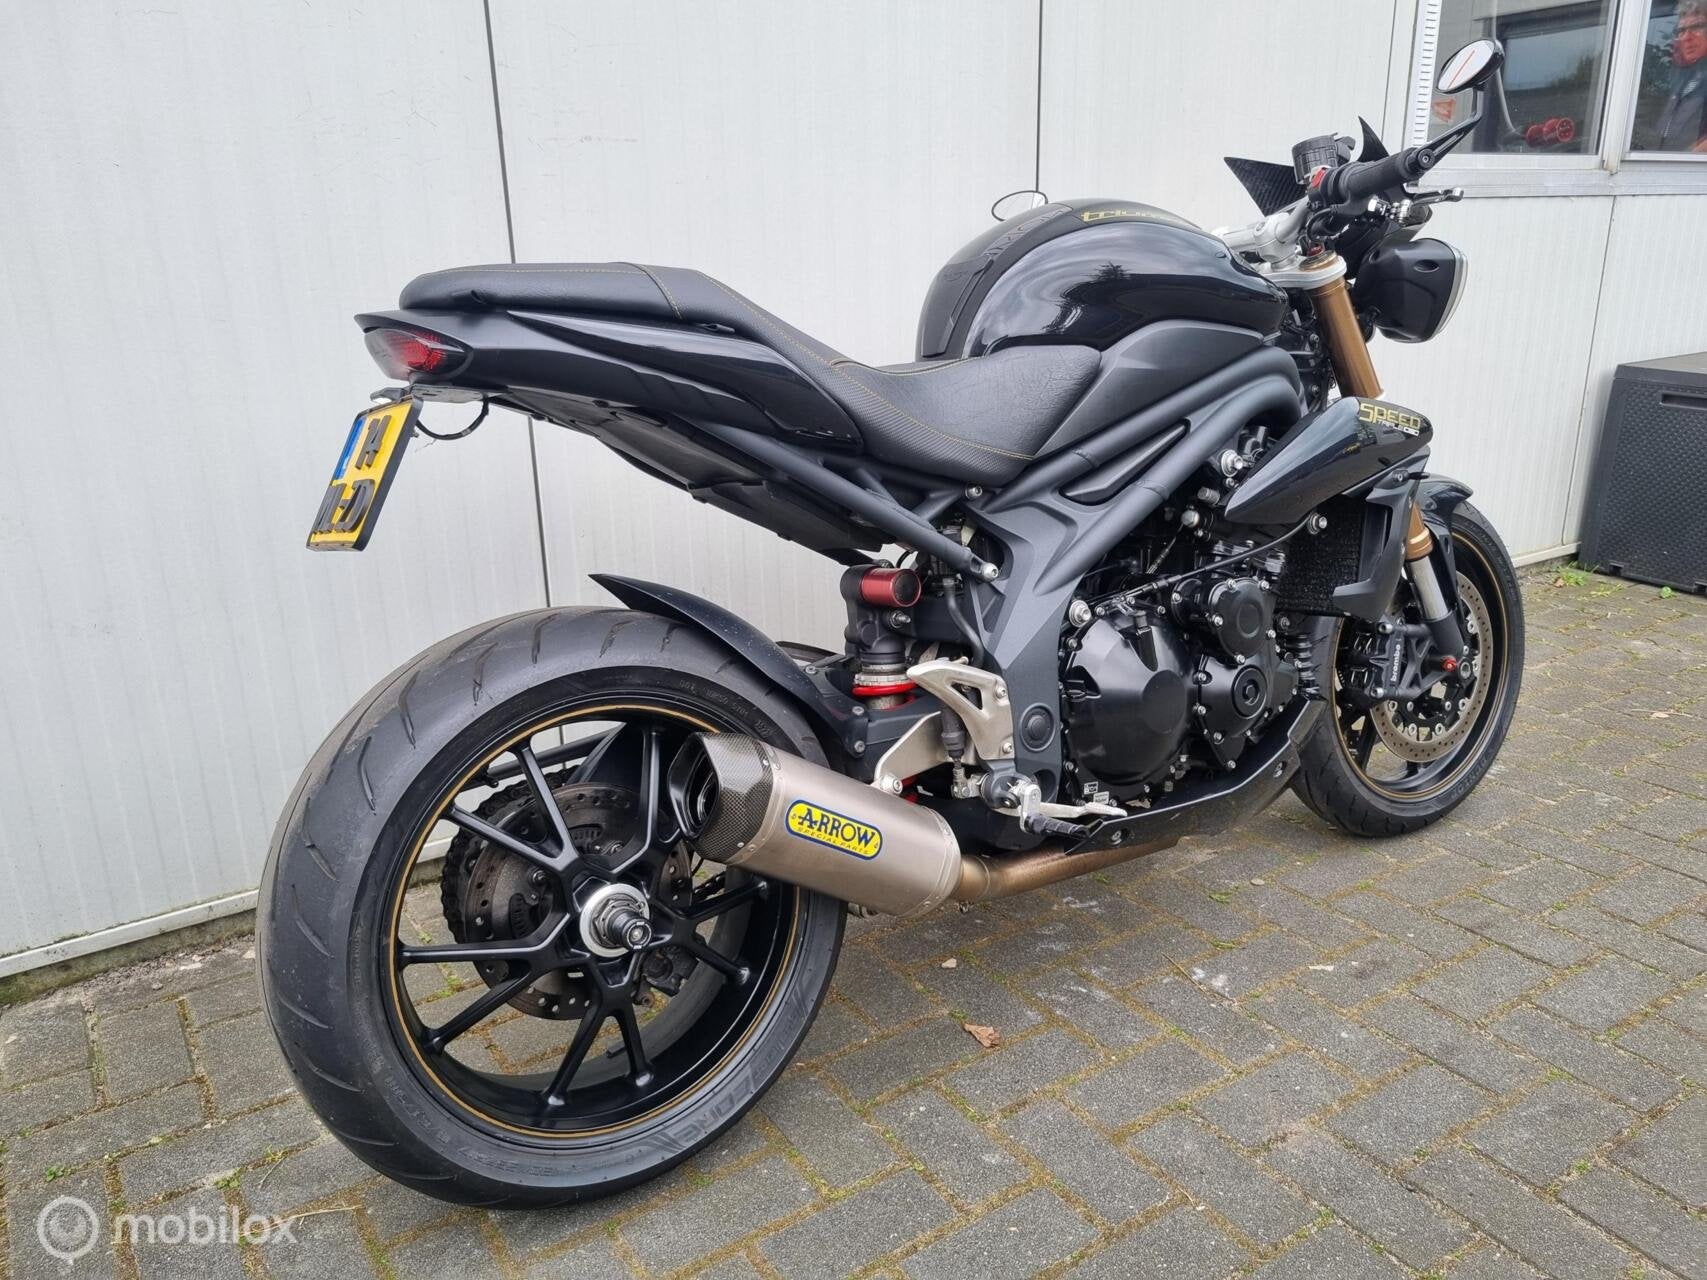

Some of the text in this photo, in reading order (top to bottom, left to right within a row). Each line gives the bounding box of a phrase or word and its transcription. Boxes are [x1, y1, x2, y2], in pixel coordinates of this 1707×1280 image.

[1359, 402, 1420, 430] SPEED
[1390, 643, 1401, 682] brembo
[798, 807, 876, 848] ARROW
